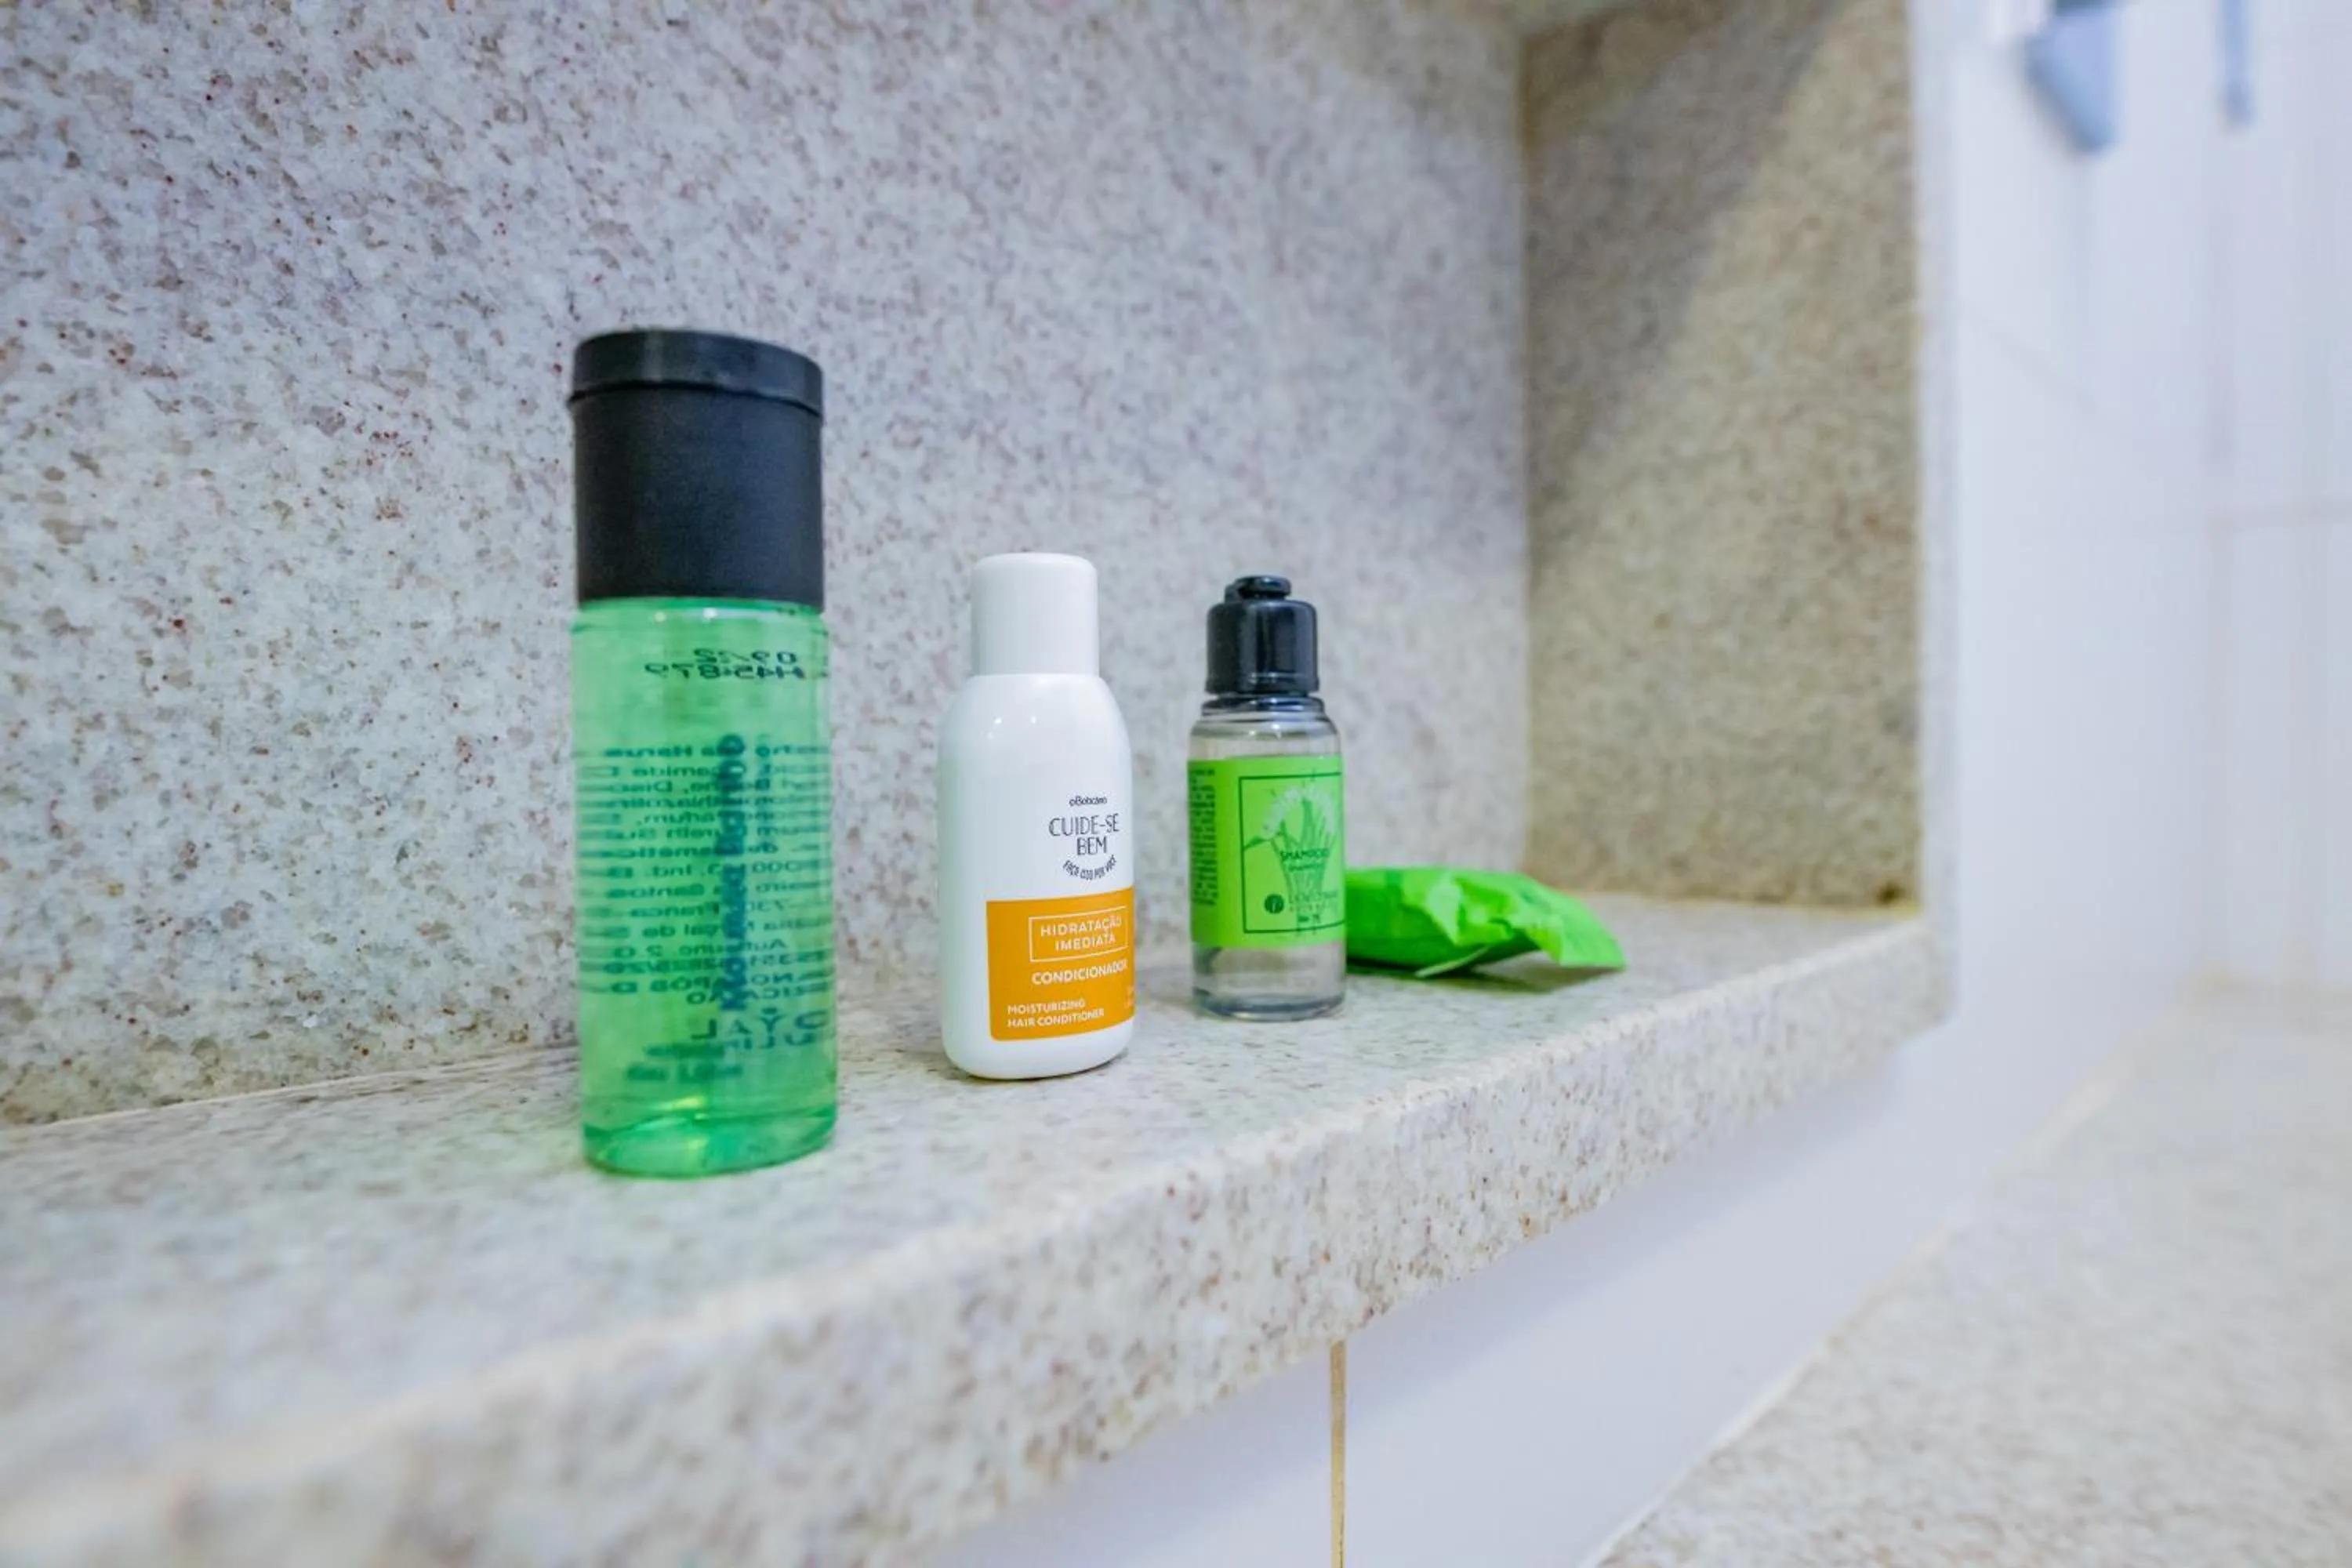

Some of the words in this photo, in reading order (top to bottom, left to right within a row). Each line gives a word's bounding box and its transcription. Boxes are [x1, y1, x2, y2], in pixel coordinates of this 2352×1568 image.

[1048, 813, 1120, 837] CUIDE-SE
[1076, 836, 1107, 855] BEM
[1040, 914, 1122, 937] HIDRATAÇÃO
[1055, 932, 1116, 951] IMEDIATA
[1031, 959, 1128, 985] CONDICIONADOR
[1007, 998, 1086, 1014] MOISTURIZING
[1007, 1018, 1035, 1028] HAIR
[1037, 1008, 1105, 1026] CONDITIONER
